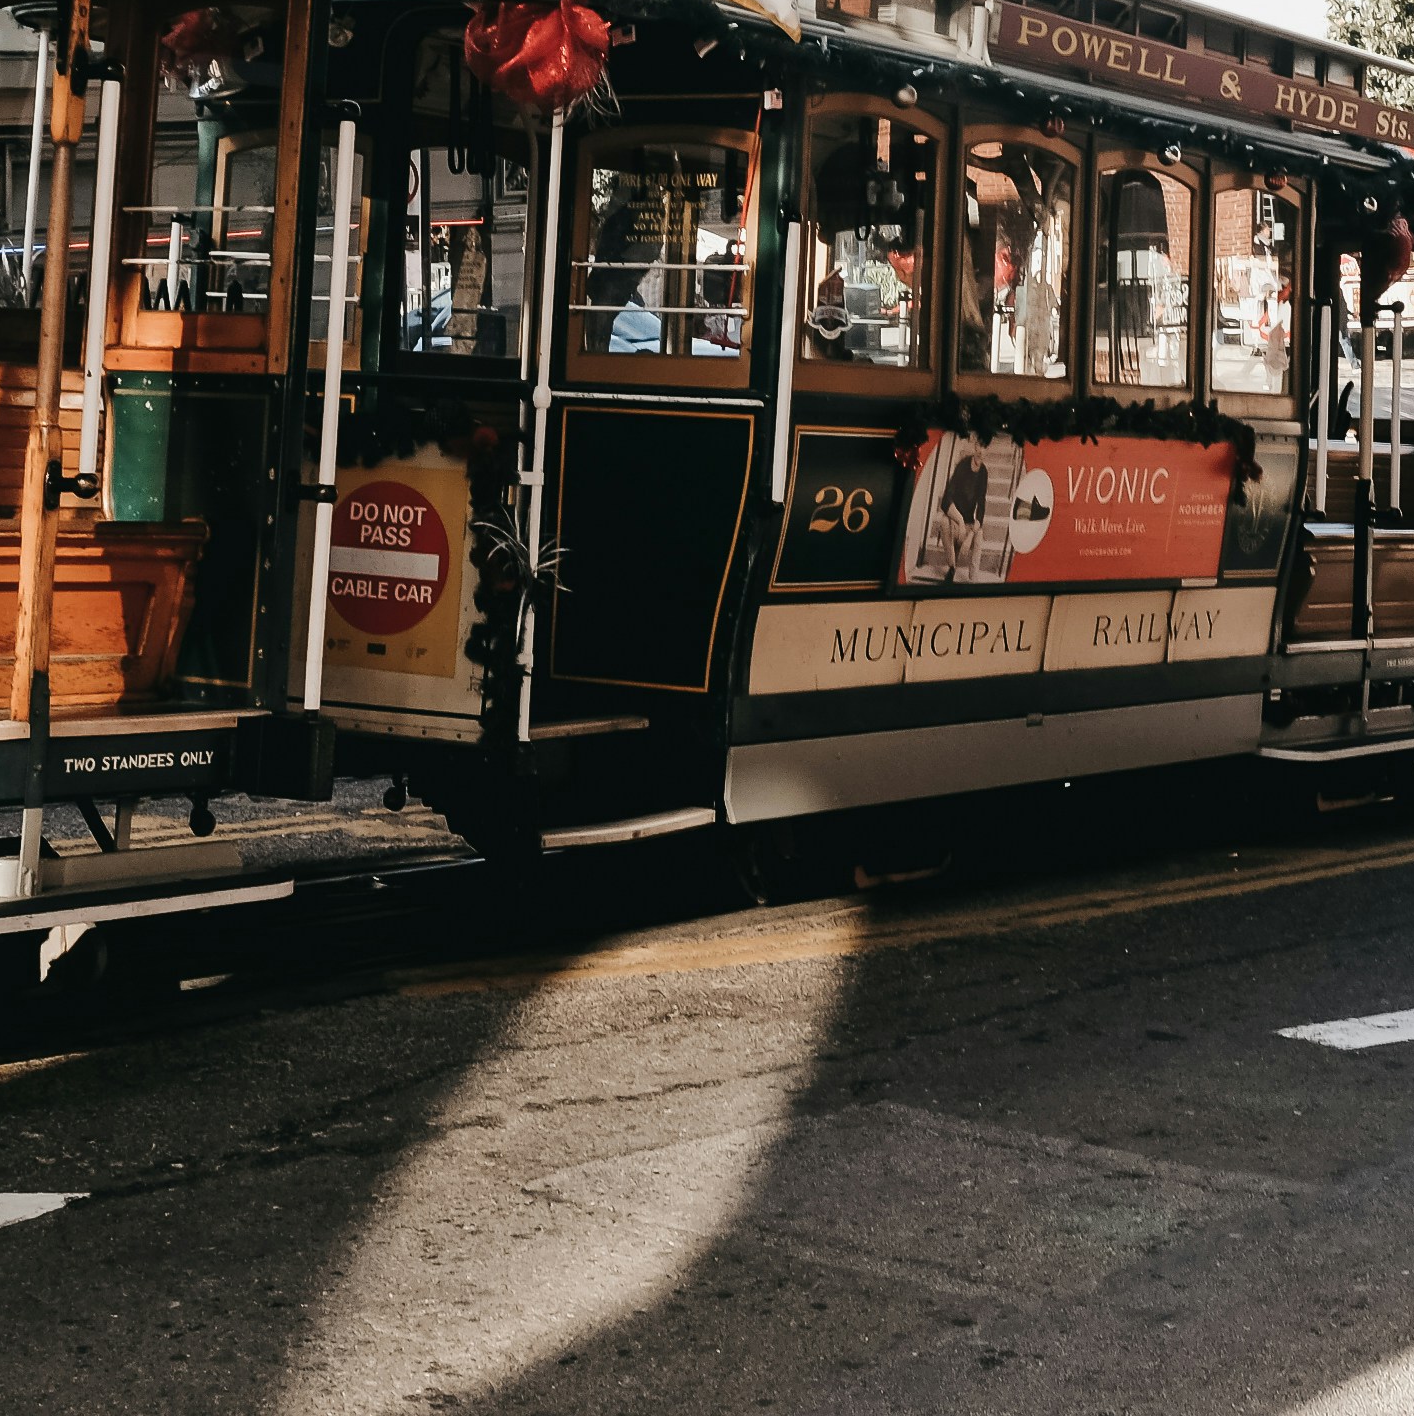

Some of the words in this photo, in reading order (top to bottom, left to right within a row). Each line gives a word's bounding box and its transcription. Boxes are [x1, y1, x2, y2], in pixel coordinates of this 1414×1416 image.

[1016, 15, 1187, 85] POWELL
[1220, 69, 1243, 101] &
[1274, 83, 1359, 129] HYDE
[1376, 110, 1412, 140] Sts.
[1067, 465, 1169, 505] VIONIC
[350, 501, 379, 523] DO
[383, 504, 428, 527] NOT
[808, 485, 874, 535] 26
[360, 524, 412, 547] PASS
[331, 577, 388, 601] CABLE
[394, 584, 433, 605] CAR
[830, 618, 1033, 664] MUNICIPAL
[1093, 609, 1221, 647] RAILWAY
[63, 757, 96, 774] TWO
[101, 753, 176, 772] STANDEES
[180, 751, 214, 767] ONLY
